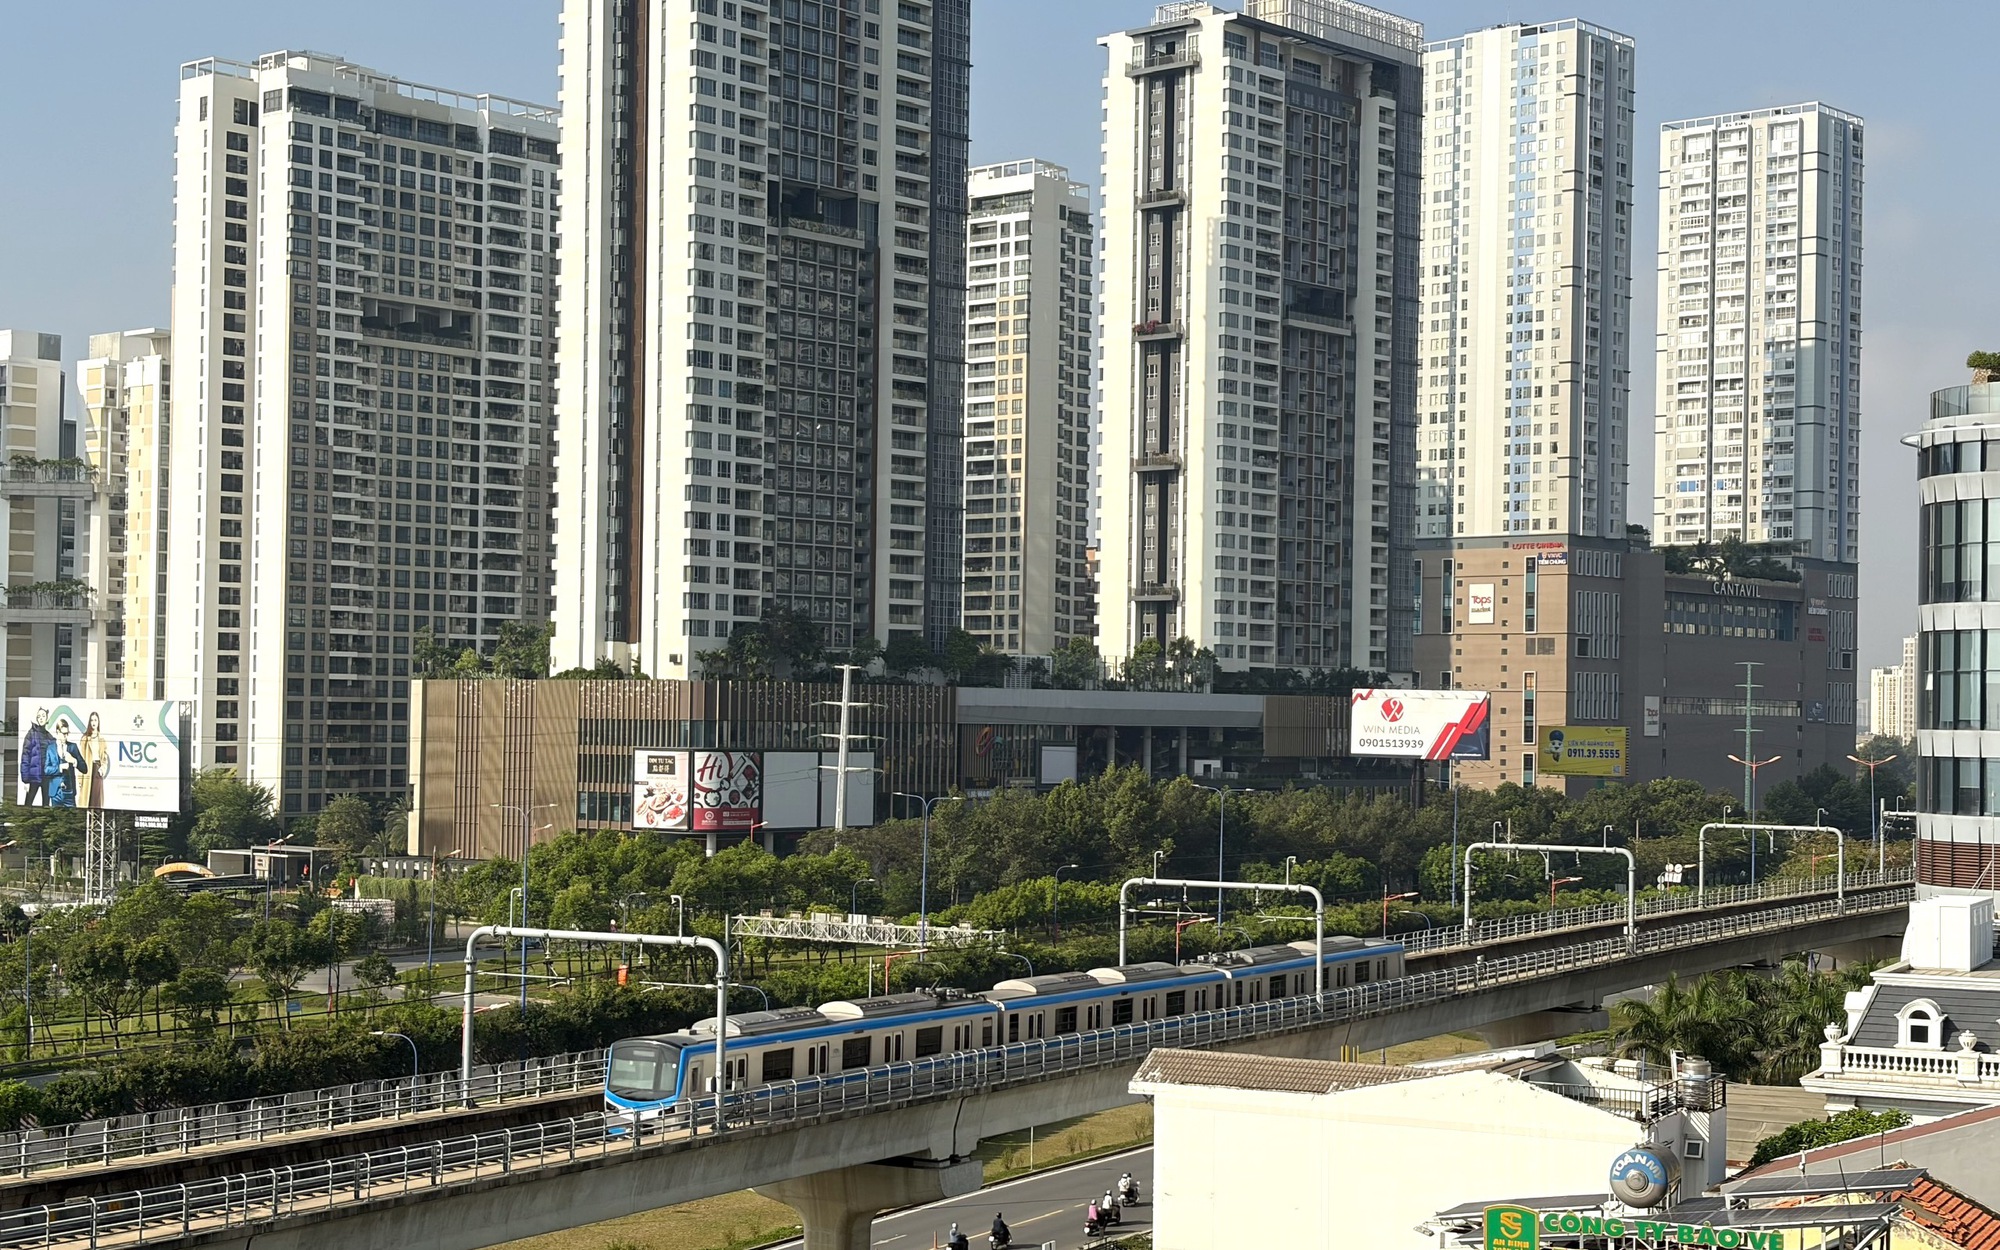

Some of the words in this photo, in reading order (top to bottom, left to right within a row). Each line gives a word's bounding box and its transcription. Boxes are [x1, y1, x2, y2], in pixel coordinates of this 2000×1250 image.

[1713, 582, 1761, 598] CANTAVIL
[1471, 596, 1492, 606] Tops
[1363, 725, 1385, 734] WIN
[1389, 726, 1420, 735] MEDIA
[1359, 738, 1424, 749] 0901513939
[119, 741, 157, 763] NBC
[1567, 749, 1620, 758] 0911.39.5555
[697, 753, 725, 782] Hi
[1543, 1209, 1625, 1237] CÔNG
[1634, 1220, 1668, 1241] TY
[1677, 1220, 1741, 1249] BẢO
